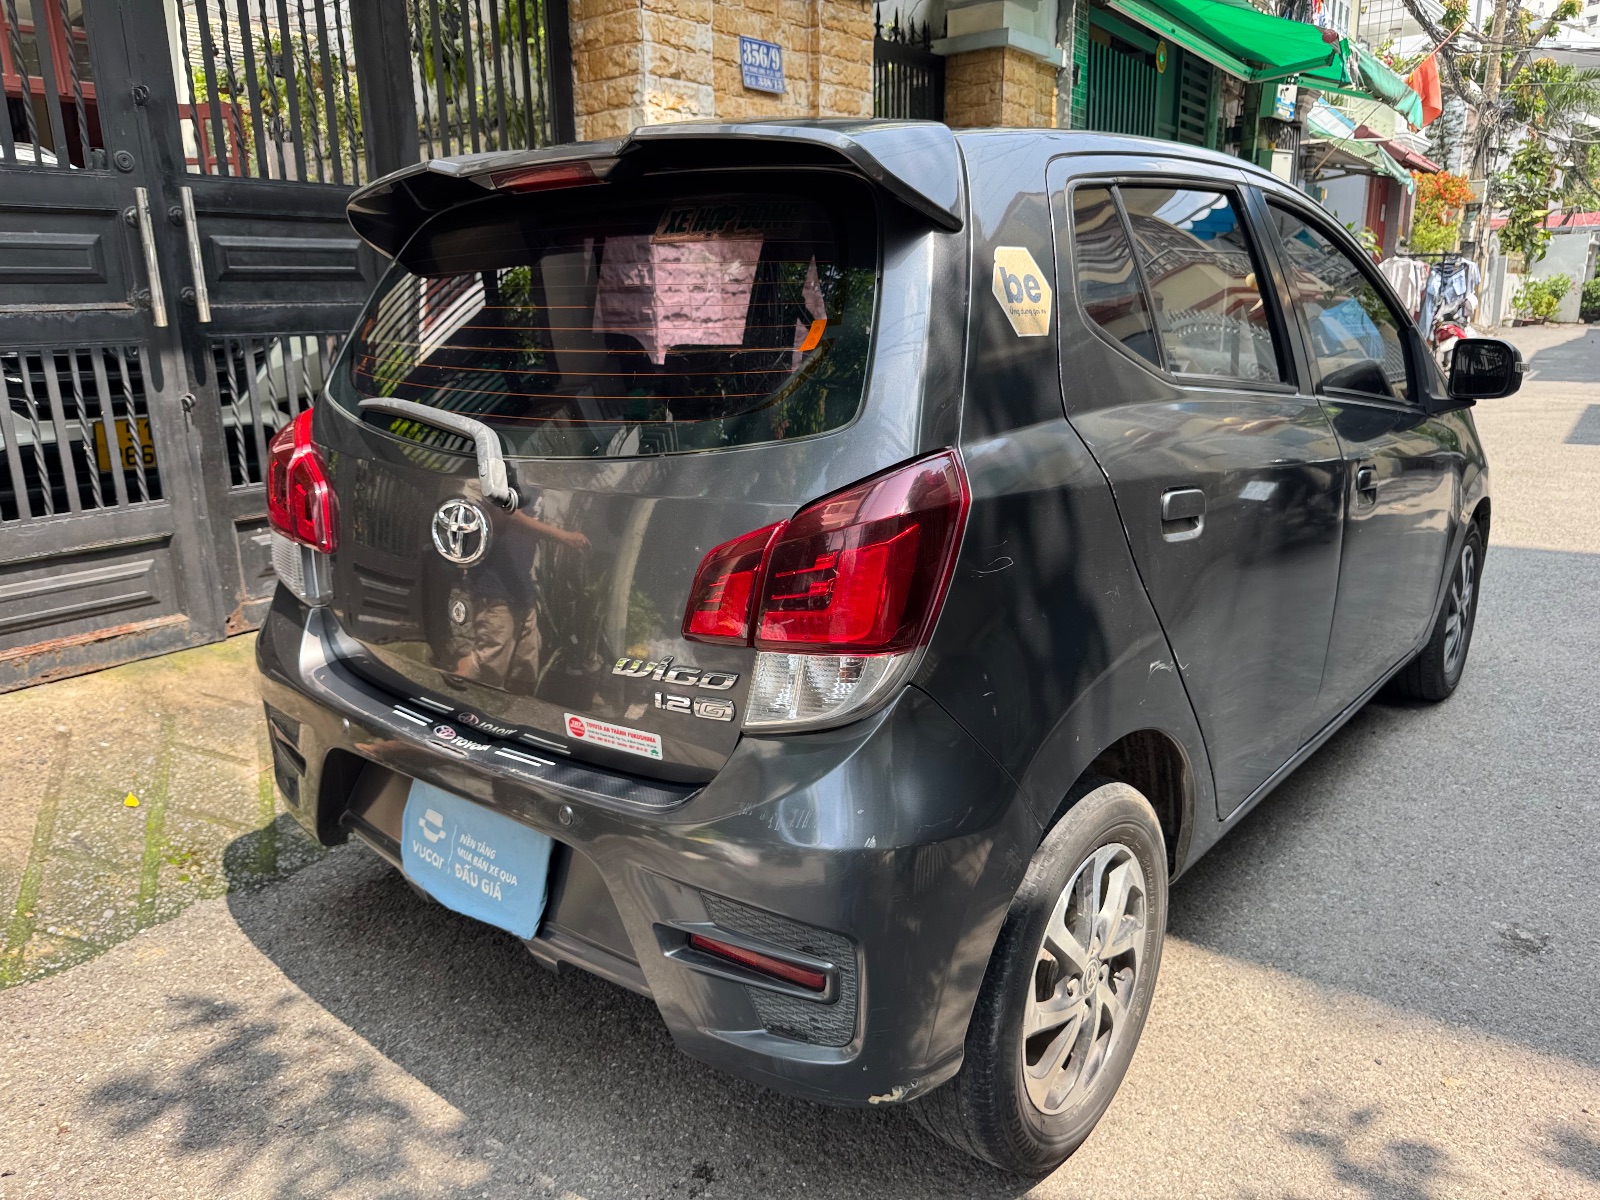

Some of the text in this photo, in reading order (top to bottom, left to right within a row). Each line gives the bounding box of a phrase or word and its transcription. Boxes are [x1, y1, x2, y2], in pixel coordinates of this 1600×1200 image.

[743, 41, 780, 70] 356/9
[999, 267, 1041, 303] be
[450, 735, 492, 751] TOYOTA
[586, 722, 602, 730] TOYOTA
[627, 732, 657, 743] FUKUSHIMA
[459, 833, 497, 859] NỀN TẢNG
[457, 847, 518, 886] MUA BÁN XE QUA
[481, 879, 502, 901] GIÁ
